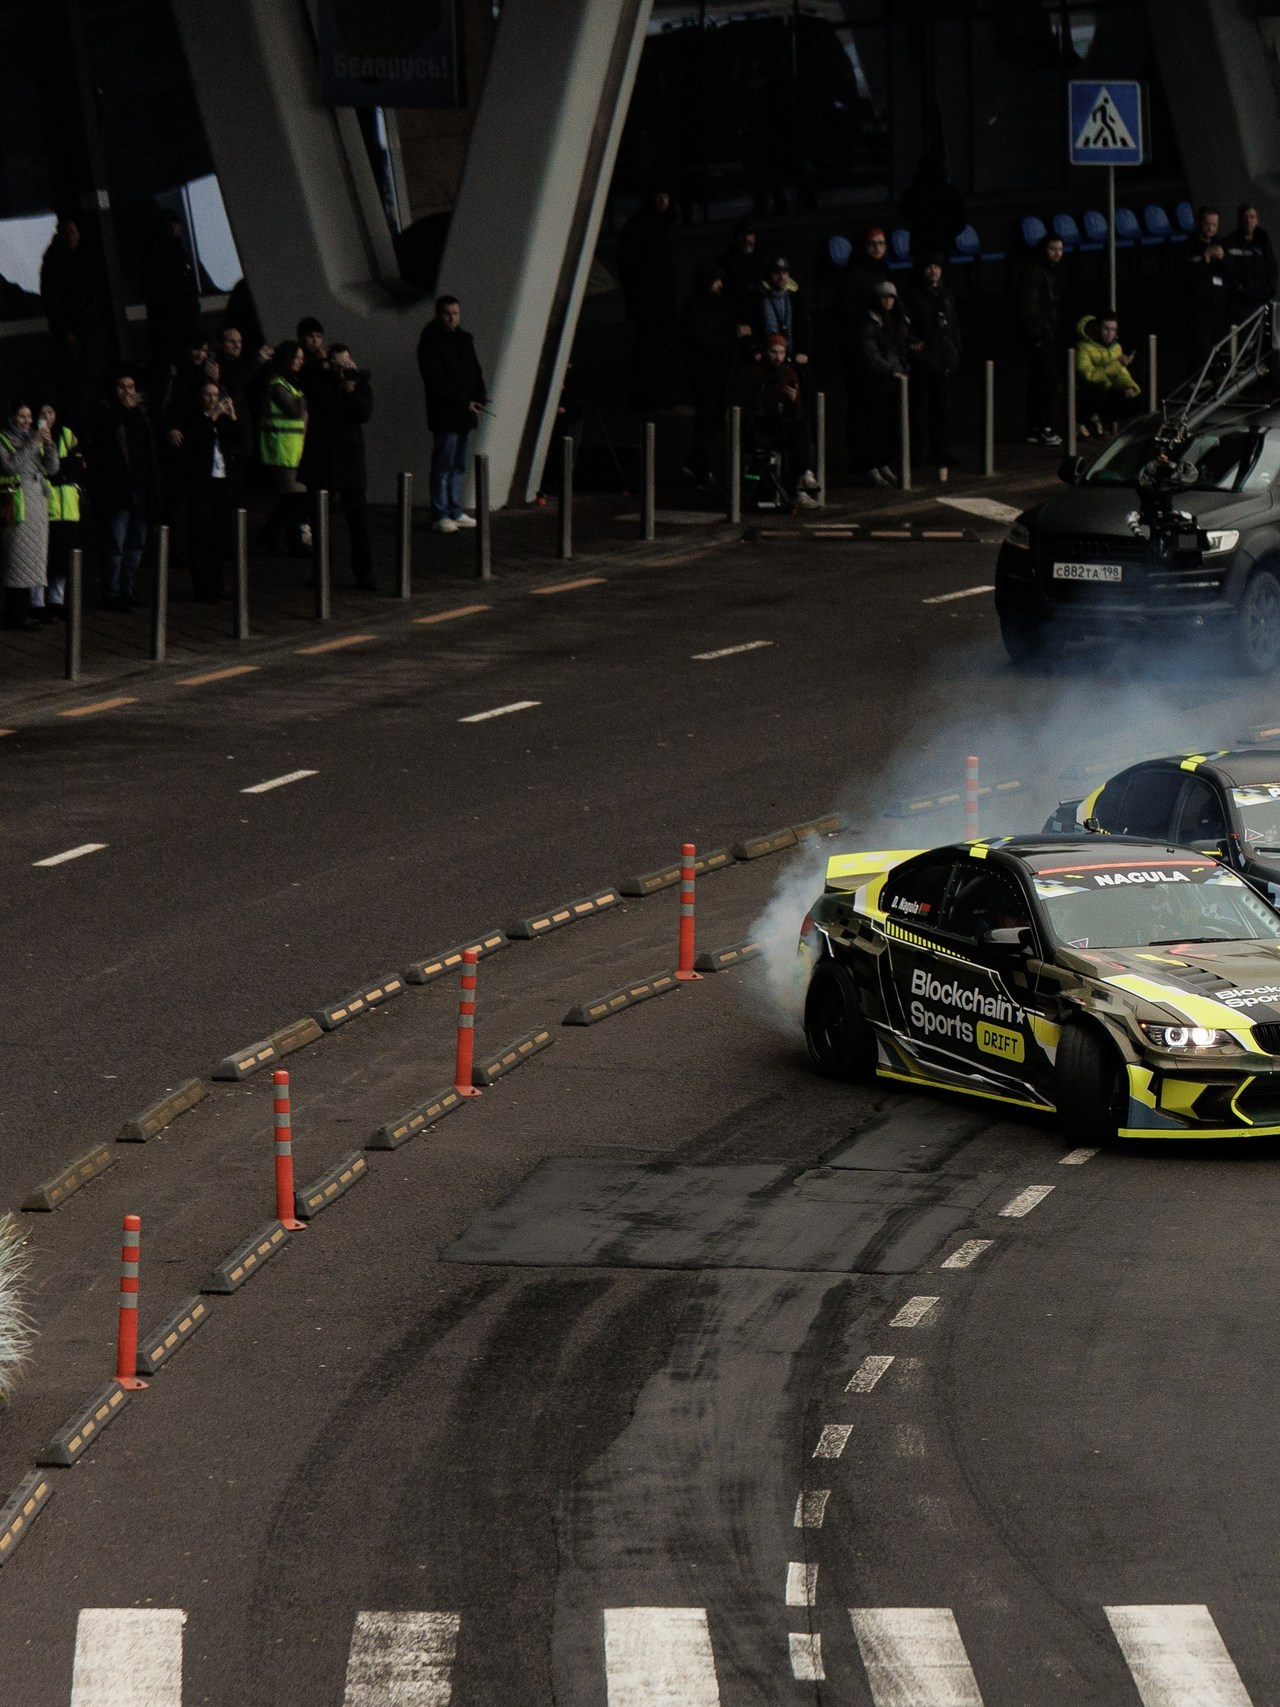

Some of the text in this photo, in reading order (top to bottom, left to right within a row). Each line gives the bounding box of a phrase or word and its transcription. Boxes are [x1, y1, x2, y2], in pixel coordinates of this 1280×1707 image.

[1093, 870, 1191, 886] NAGULA
[890, 895, 919, 914] D. Nagula
[911, 968, 1013, 1023] Blockchain
[910, 1000, 1018, 1055] Sports DRIFT
